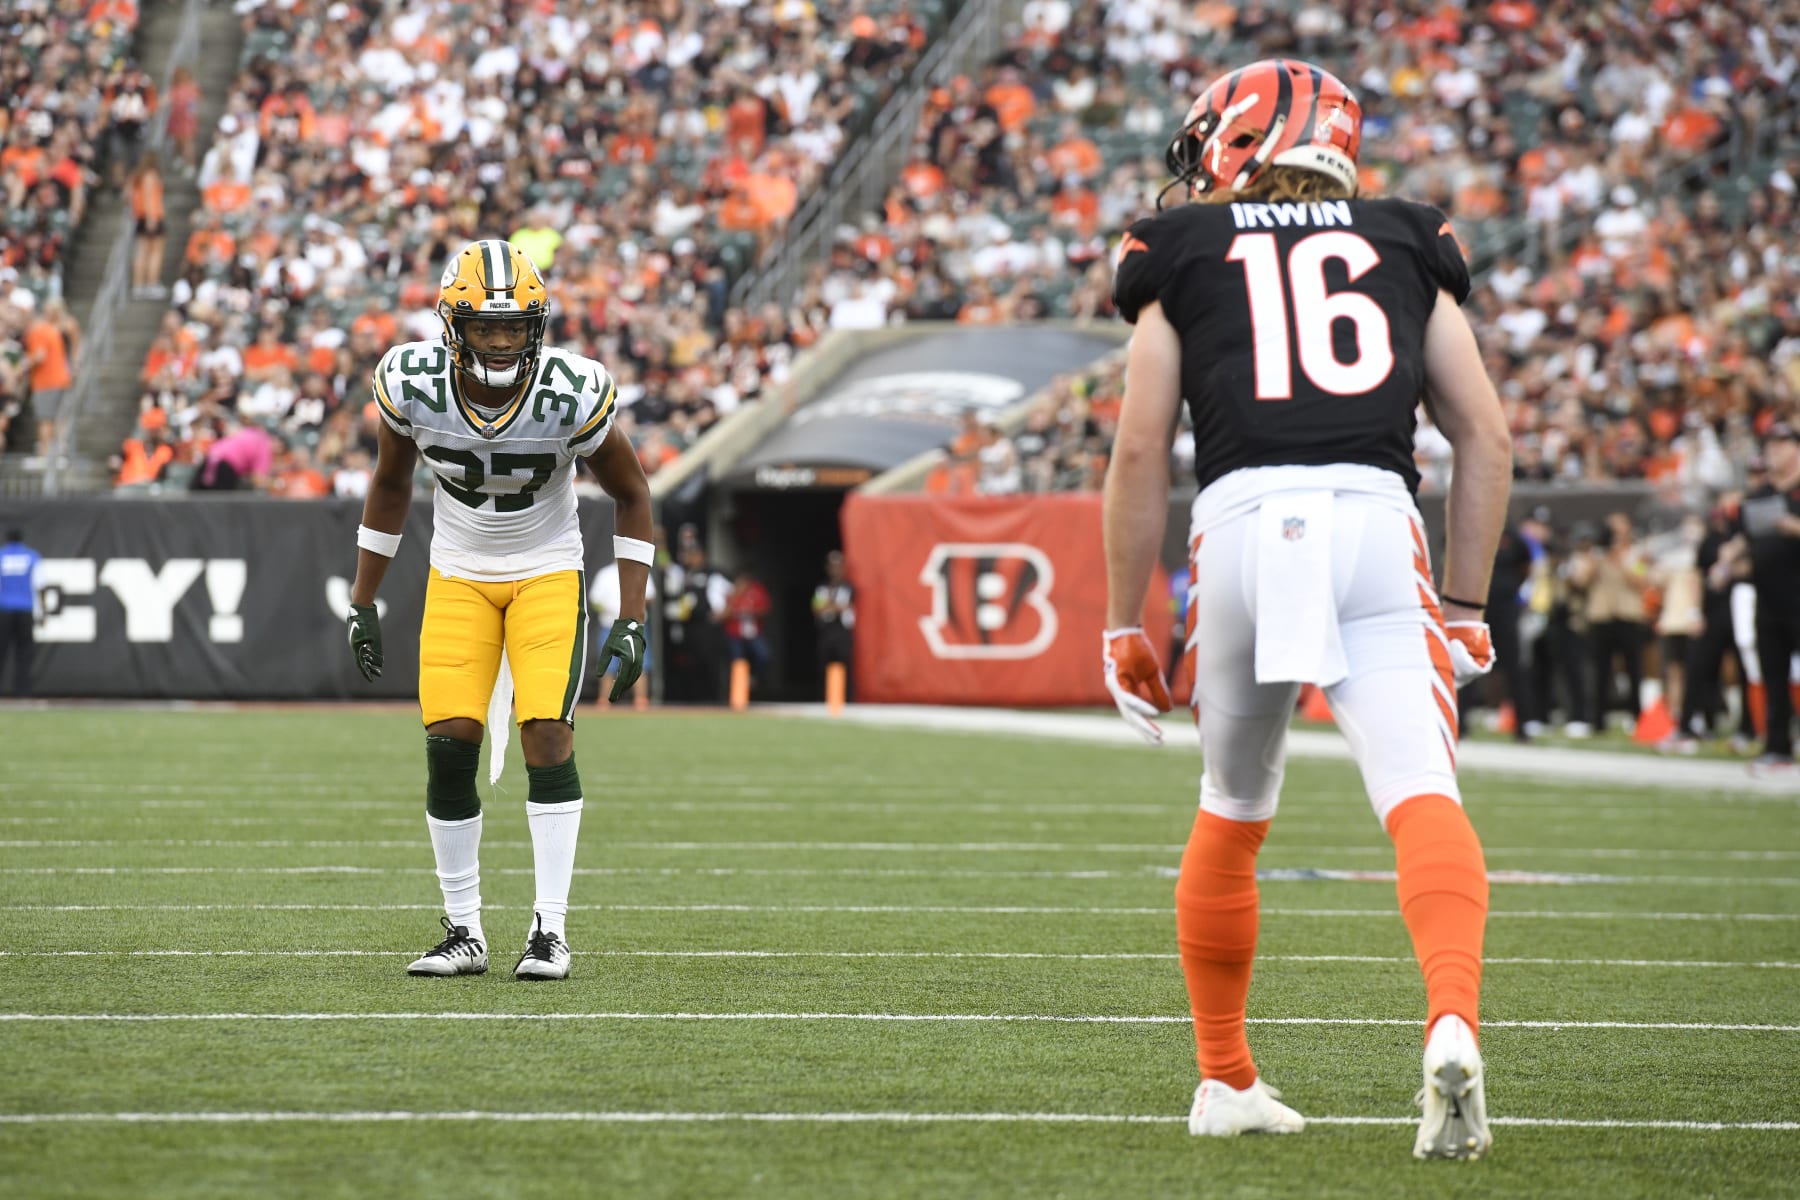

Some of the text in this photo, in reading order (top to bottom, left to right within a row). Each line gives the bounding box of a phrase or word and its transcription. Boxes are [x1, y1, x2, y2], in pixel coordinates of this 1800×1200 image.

[1230, 200, 1353, 229] IRWIN
[1224, 229, 1395, 401] 16
[400, 346, 447, 413] 37
[532, 356, 587, 426] 37
[422, 444, 557, 513] 37
[918, 542, 1059, 660] B
